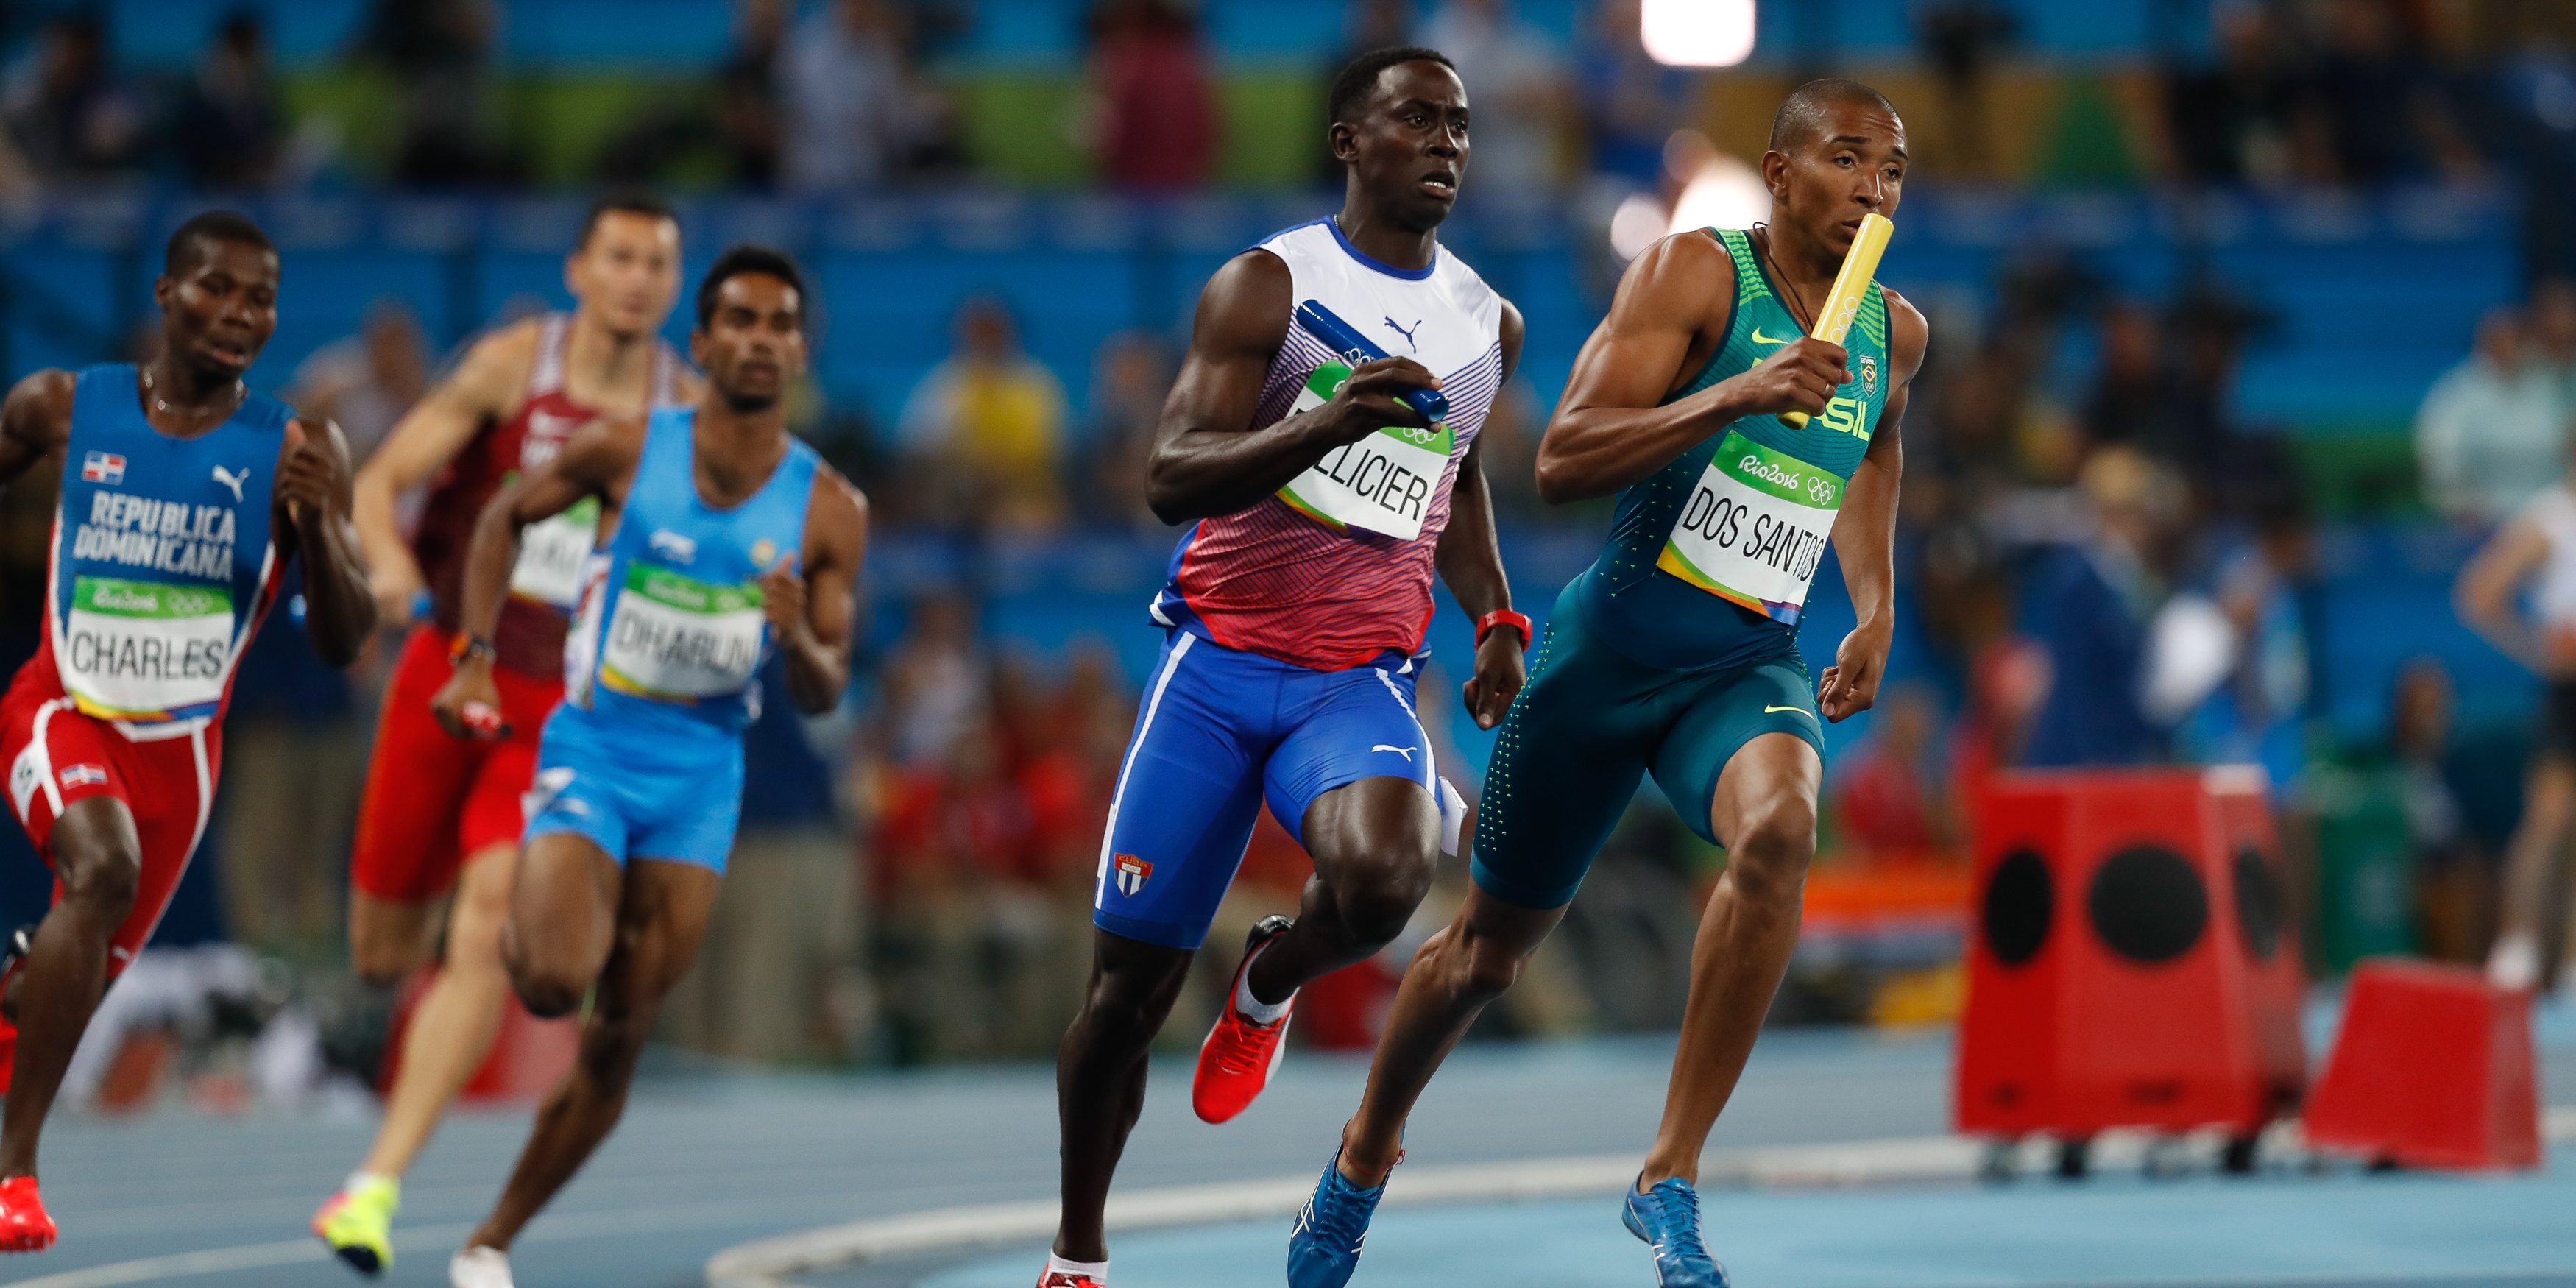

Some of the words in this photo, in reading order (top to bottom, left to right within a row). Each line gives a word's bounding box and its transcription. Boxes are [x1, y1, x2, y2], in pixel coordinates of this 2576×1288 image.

[1294, 408, 1429, 521] LICIER
[1738, 455, 1800, 490] Rio2016
[90, 489, 236, 544] REPUBLICA
[1682, 486, 1748, 548] DOS
[1743, 514, 1825, 581] SANTOS
[73, 523, 233, 582] DOMINICANA
[73, 631, 223, 679] CHARLES
